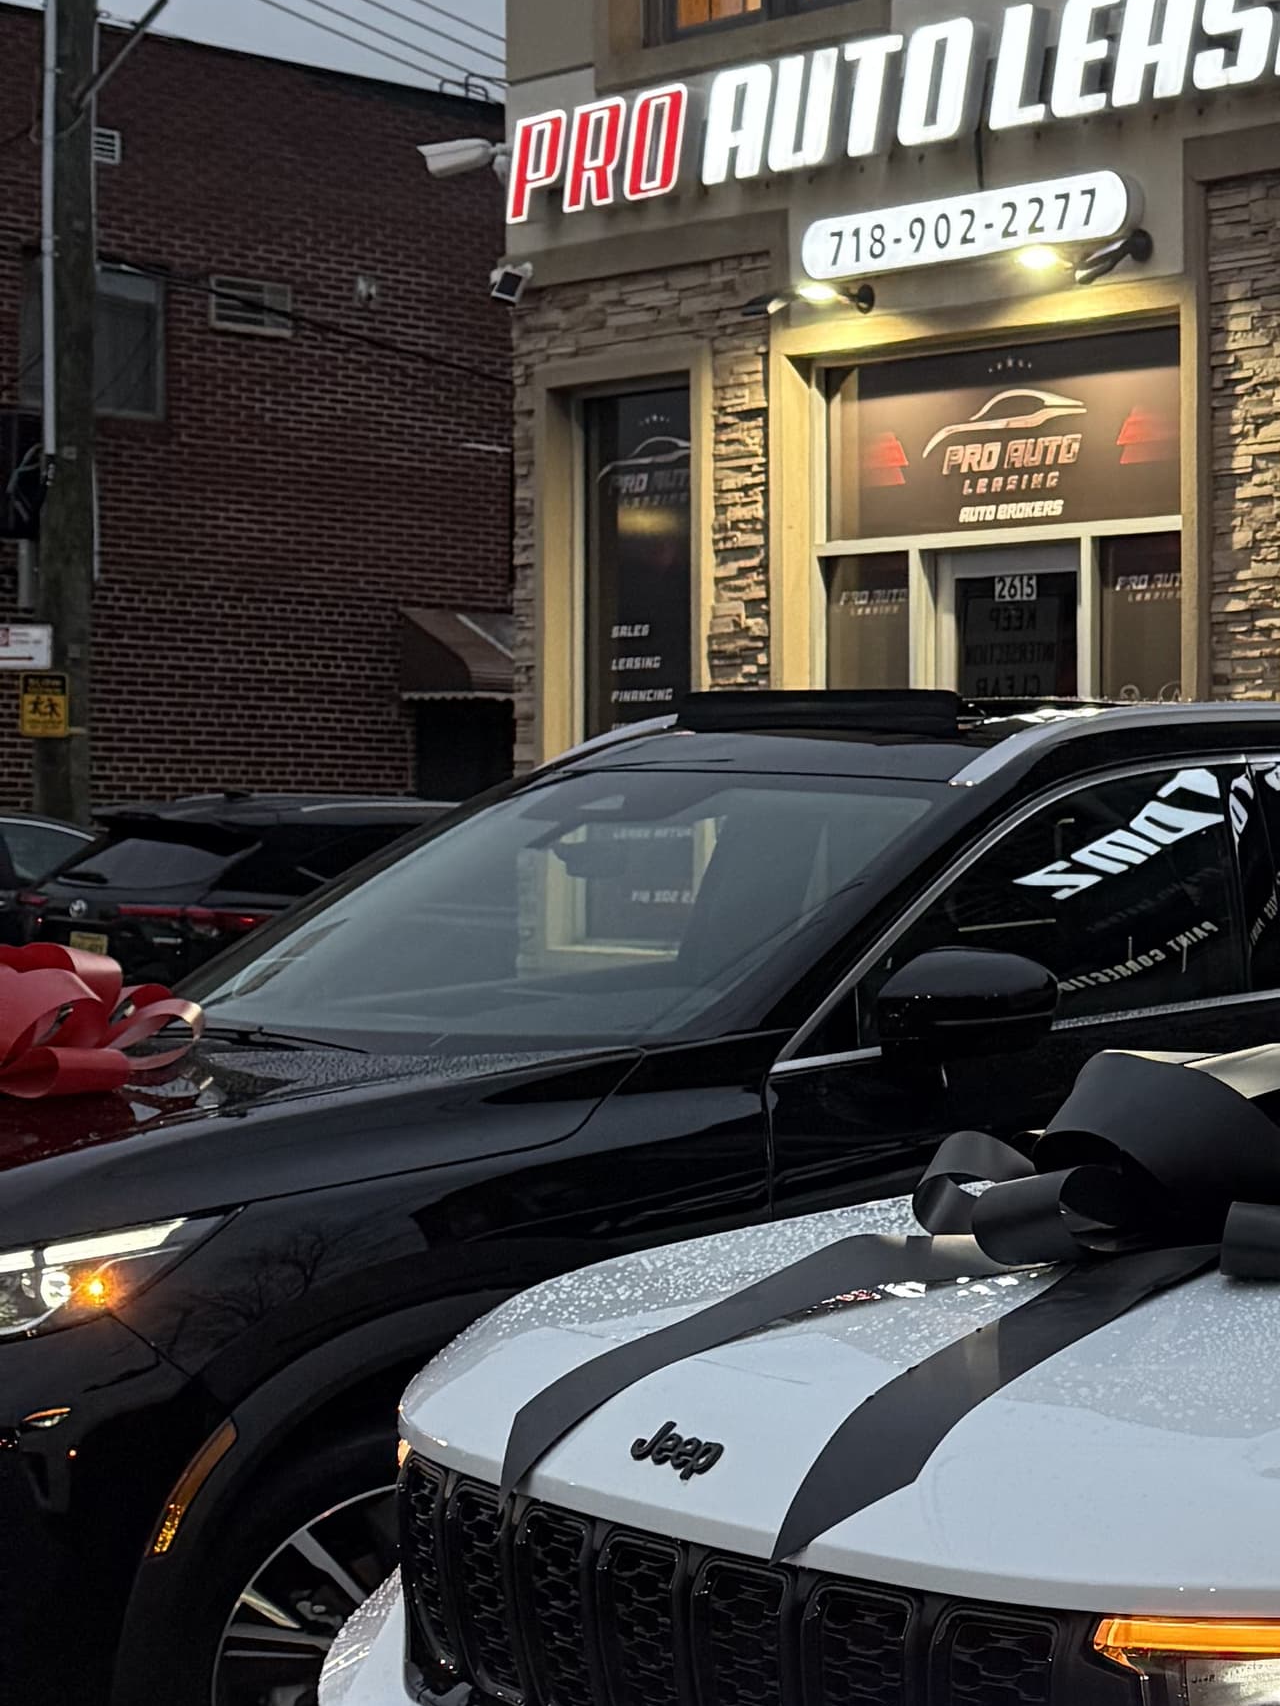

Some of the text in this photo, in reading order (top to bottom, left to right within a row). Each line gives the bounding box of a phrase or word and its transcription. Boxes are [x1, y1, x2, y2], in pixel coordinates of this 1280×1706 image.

[506, 82, 688, 225] PRO
[700, 16, 976, 186] AUTO
[828, 188, 1100, 268] 718-902-2277
[942, 432, 1084, 476] PRO AUTO
[962, 470, 1061, 496] LEASING
[958, 498, 1065, 524] AUTO BROKERS
[996, 576, 1036, 600] 2615
[611, 624, 650, 639] SALES
[611, 656, 662, 671] LEASING
[611, 688, 674, 704] FINANCING
[630, 1420, 725, 1481] Jeep
